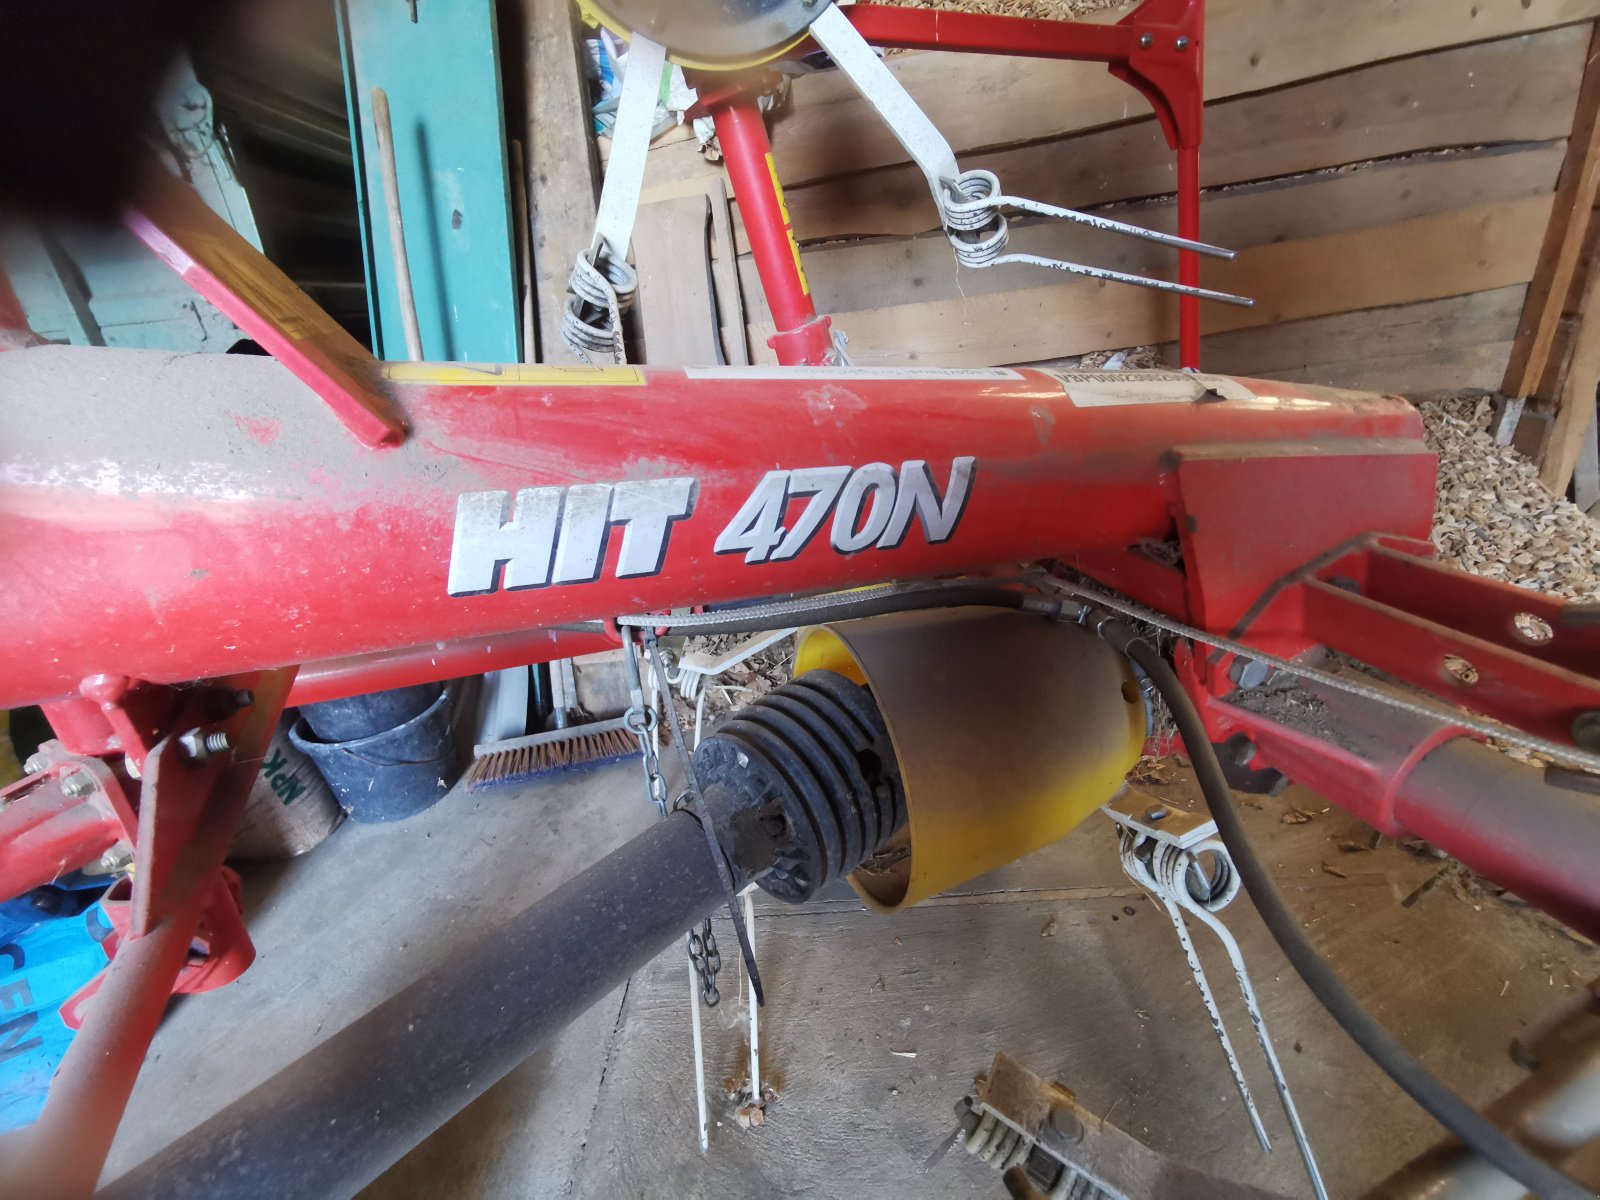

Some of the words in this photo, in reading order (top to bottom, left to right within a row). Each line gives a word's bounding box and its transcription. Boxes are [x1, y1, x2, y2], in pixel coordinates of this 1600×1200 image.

[447, 477, 699, 597] HIT
[713, 456, 977, 565] 470N
[261, 748, 306, 806] NPK
